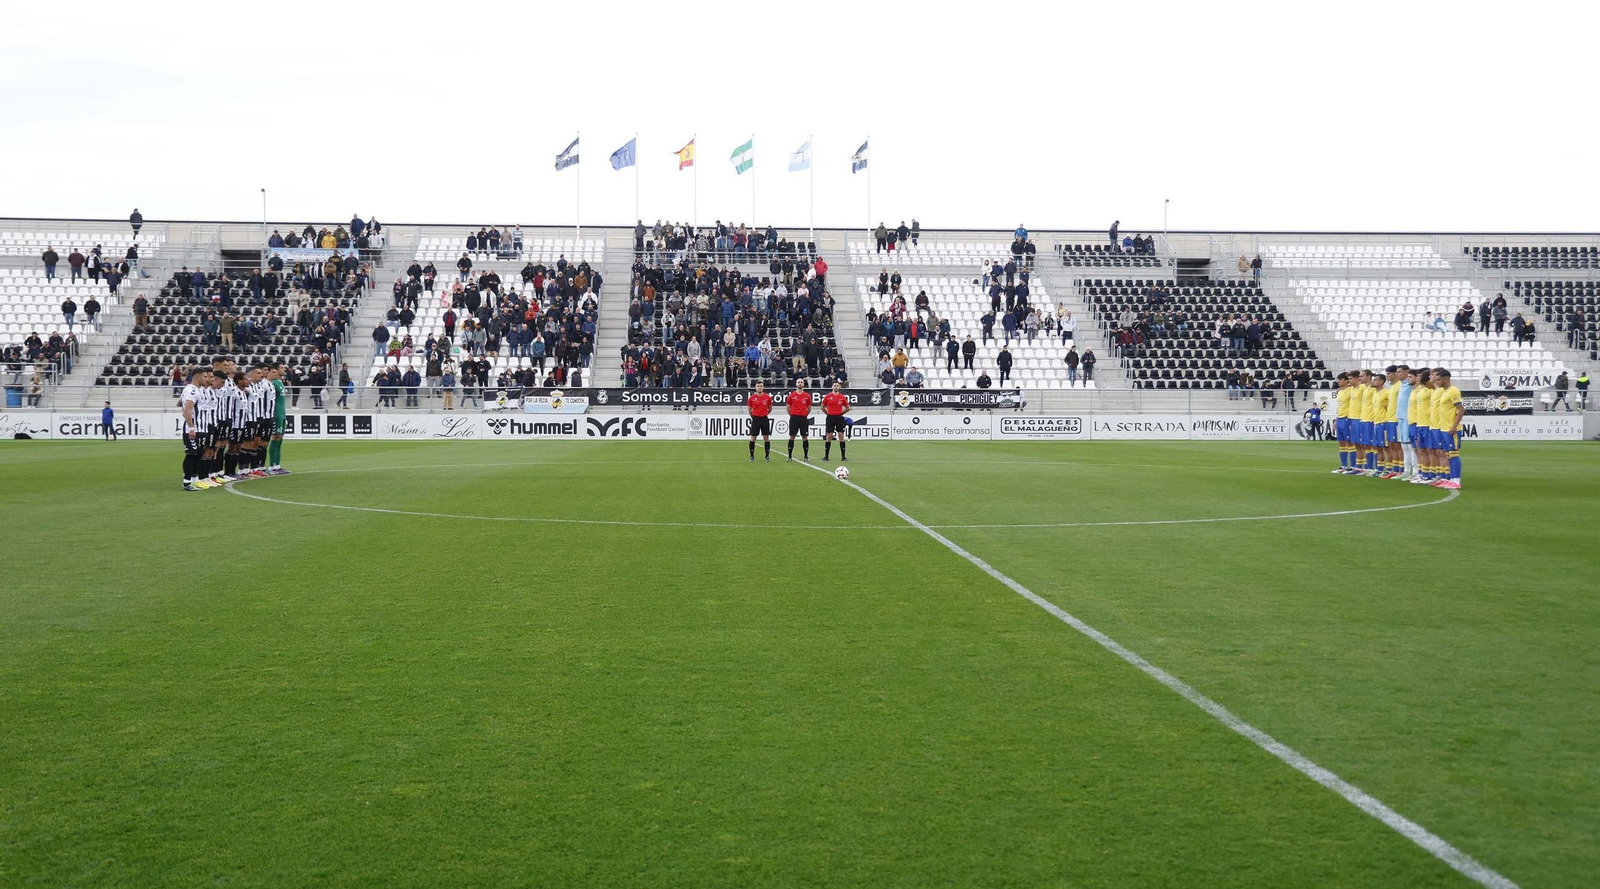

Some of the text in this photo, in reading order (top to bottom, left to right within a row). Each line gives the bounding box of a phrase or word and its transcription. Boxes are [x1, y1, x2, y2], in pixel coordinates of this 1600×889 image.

[622, 391, 669, 403] Somos
[673, 391, 689, 403] La
[693, 391, 731, 403] Recia
[735, 394, 743, 403] e
[914, 393, 944, 405] BALONA
[959, 391, 999, 405] PICHIGÜEY
[510, 418, 578, 435] hummel
[893, 426, 940, 435] feralmansa
[944, 426, 990, 435] feralmansa
[1094, 421, 1112, 432] LA
[1244, 425, 1286, 433] VELVET
